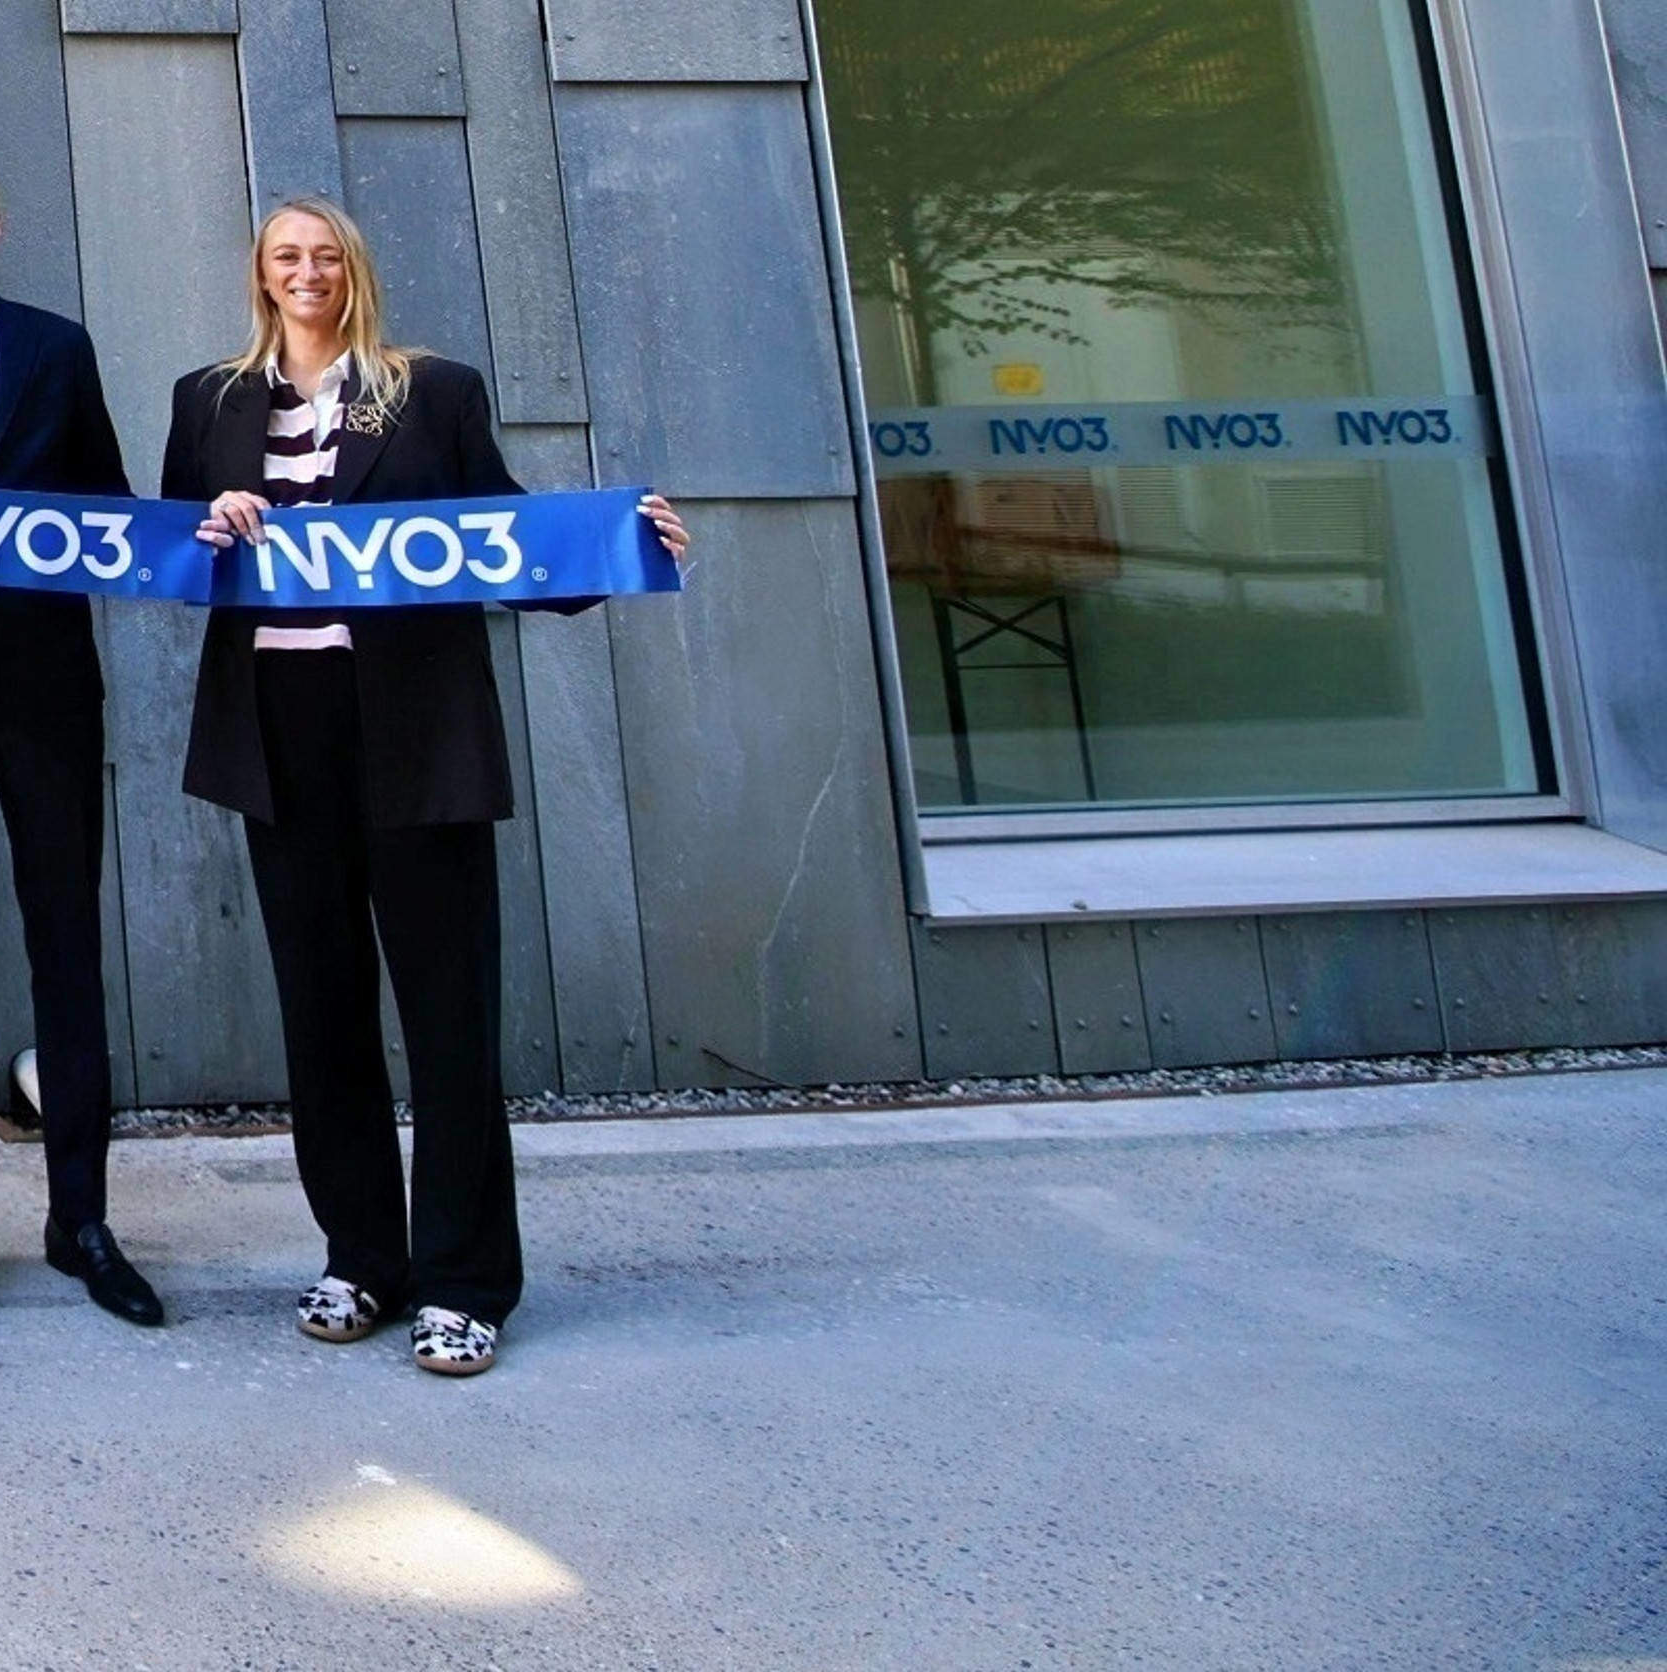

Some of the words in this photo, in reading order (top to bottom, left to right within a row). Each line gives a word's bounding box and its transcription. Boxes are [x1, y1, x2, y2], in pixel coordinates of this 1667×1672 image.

[869, 421, 932, 457] O3
[989, 417, 1109, 454] NYO3
[1164, 413, 1283, 449] NYO3
[1336, 409, 1452, 445] NYO3
[257, 512, 522, 591] NYO3
